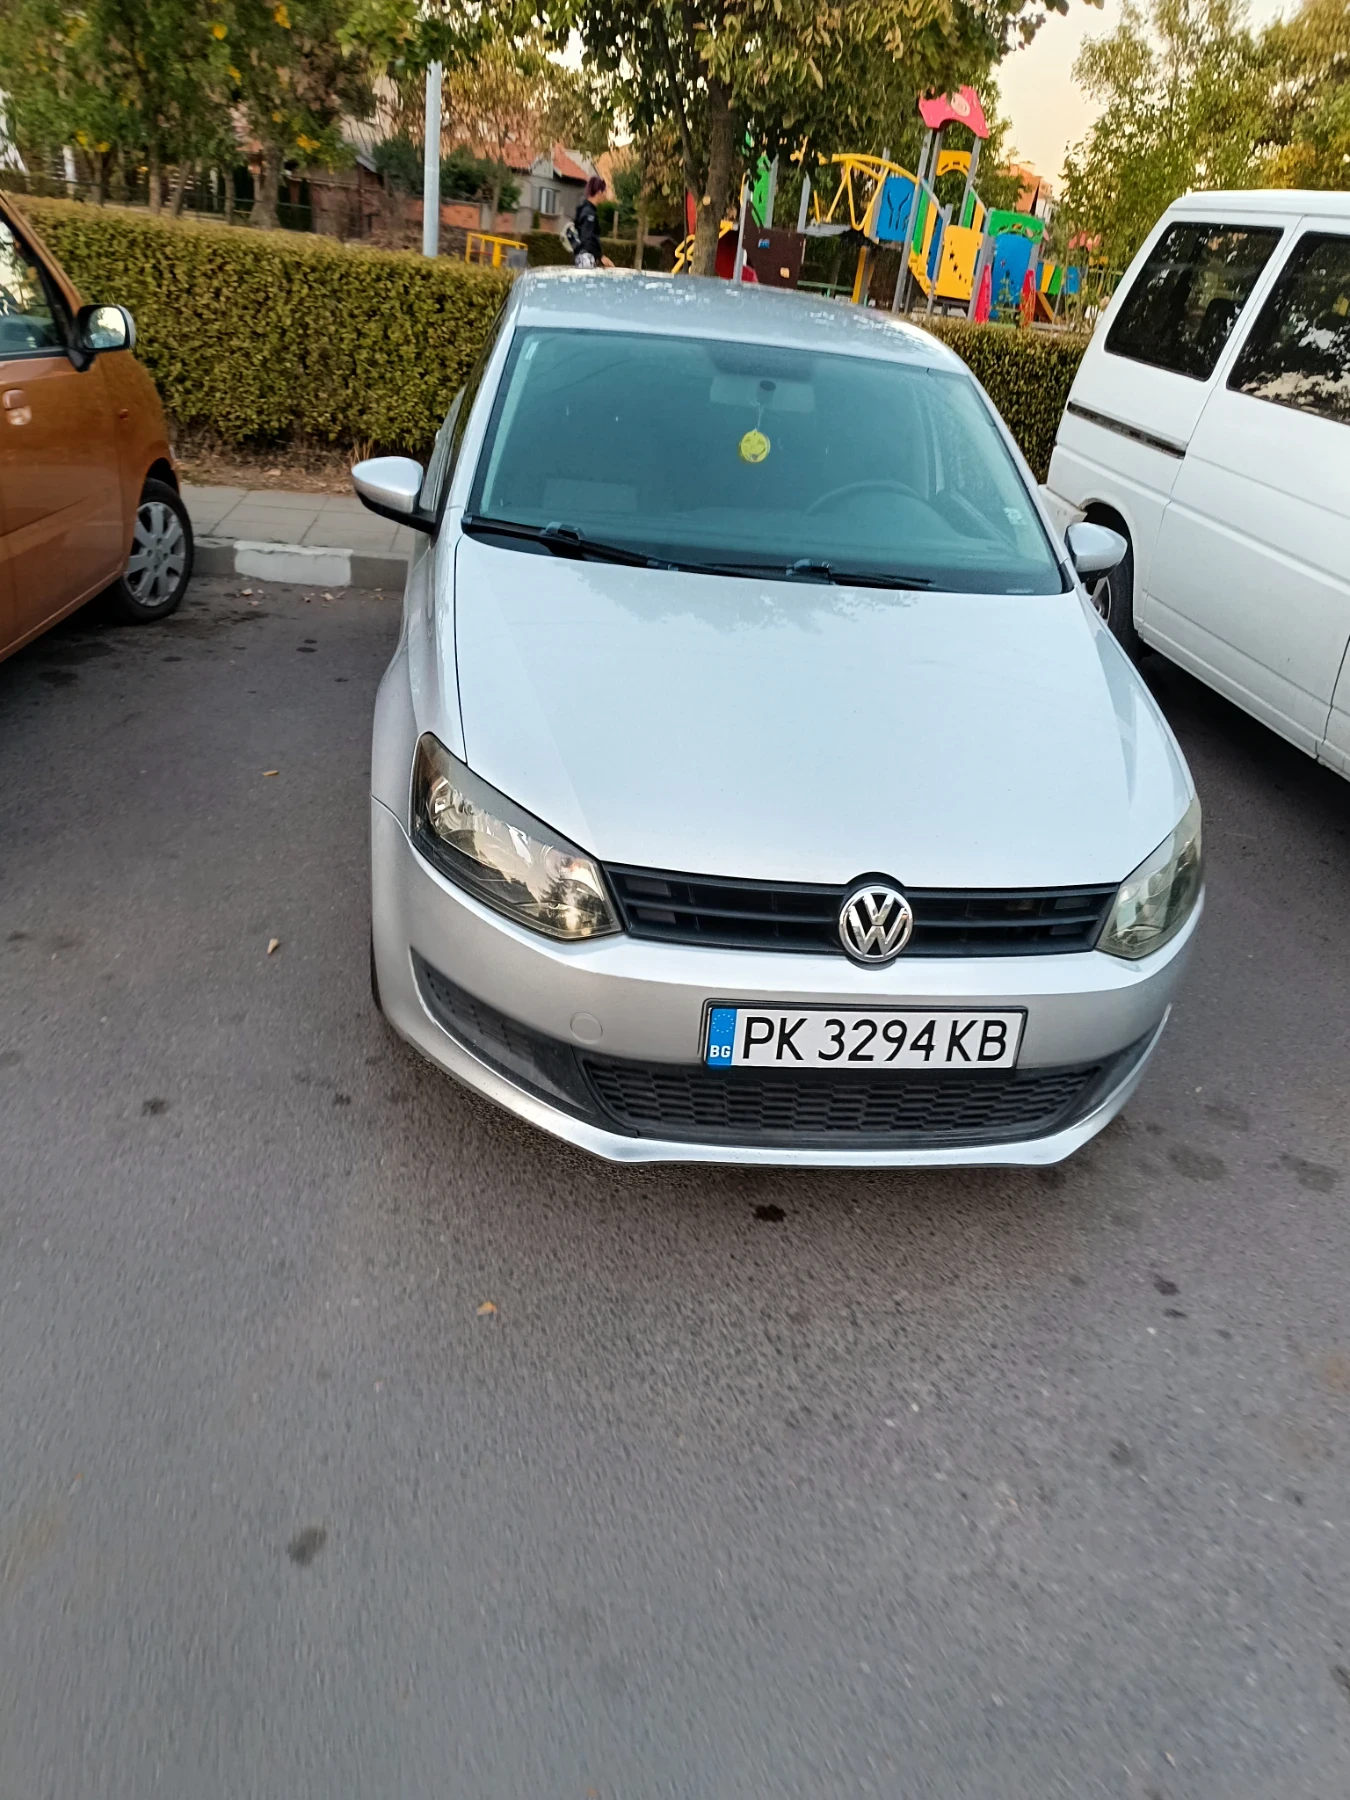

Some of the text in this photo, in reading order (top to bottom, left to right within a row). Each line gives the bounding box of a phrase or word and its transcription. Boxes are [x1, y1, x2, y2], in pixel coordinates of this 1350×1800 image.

[844, 889, 911, 958] VW
[709, 1045, 732, 1058] BG
[742, 1016, 1008, 1062] PK 3294 KB
